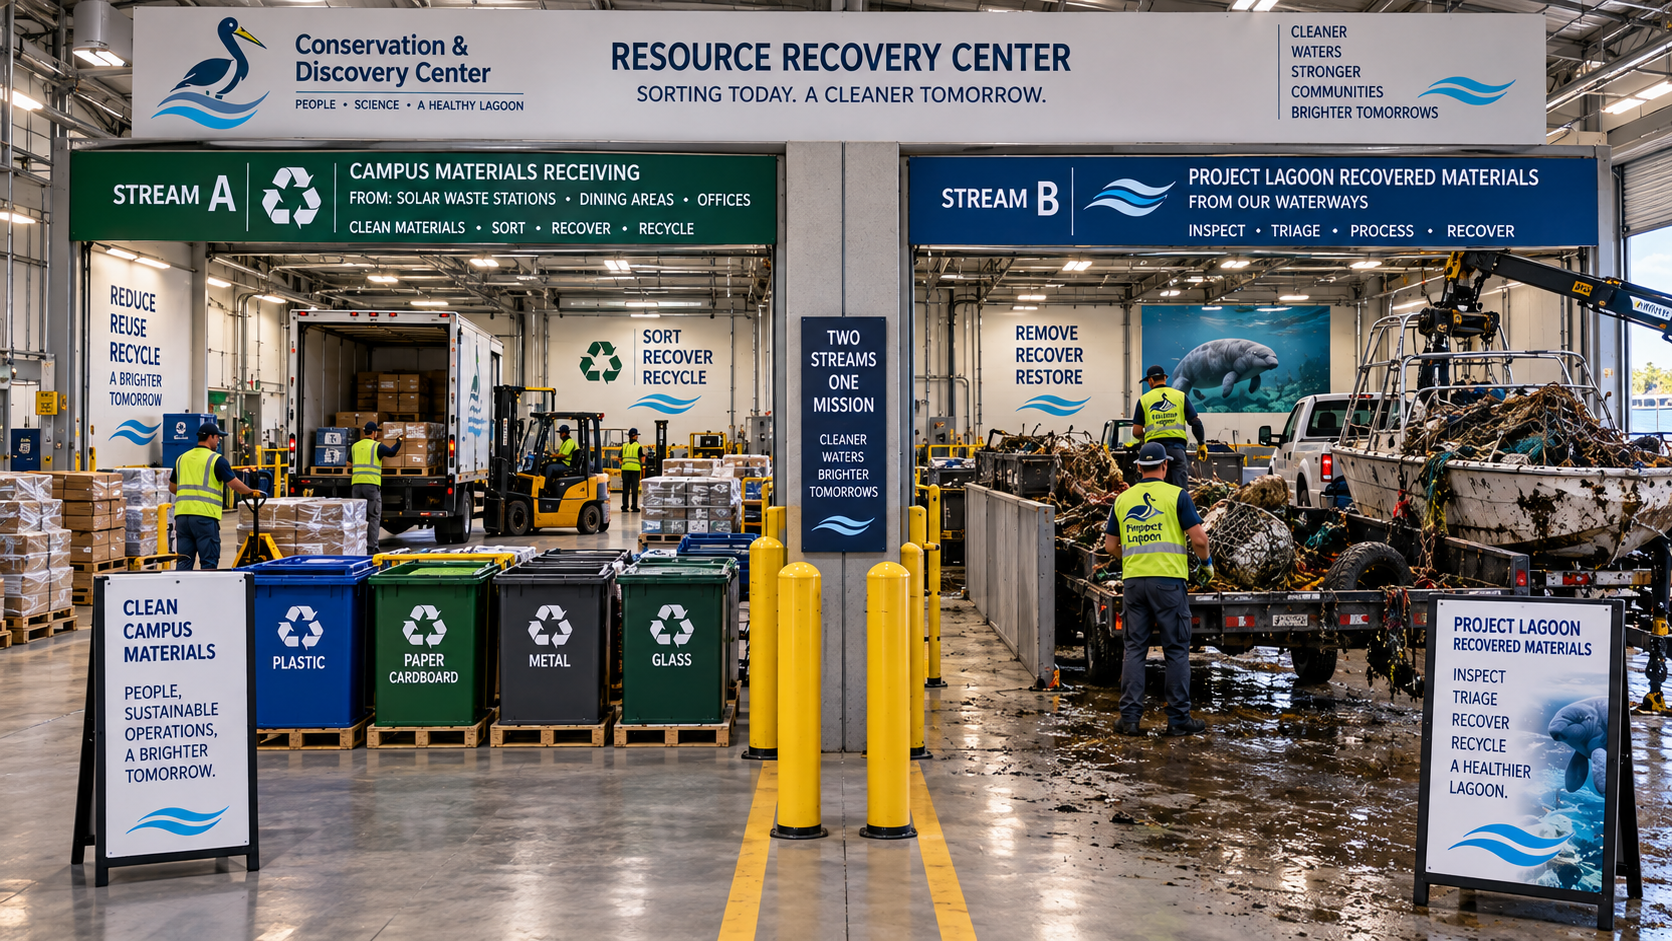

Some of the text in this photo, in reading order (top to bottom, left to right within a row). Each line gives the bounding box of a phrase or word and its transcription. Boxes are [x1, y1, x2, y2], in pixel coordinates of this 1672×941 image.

[1291, 25, 1346, 38] CLEANER
[295, 33, 468, 56] Conservation &
[1292, 46, 1341, 58] WATERS
[613, 42, 1071, 71] RESOURCE RECOVERY CENTER
[296, 61, 491, 87] Discovery Center
[1292, 66, 1360, 77] STRONGER
[638, 86, 1045, 103] SORTING TODAY. A CLEANER TOMORROW.
[1292, 86, 1383, 98] COMMUNITIES
[296, 100, 523, 110] PEOPLE SCIENCE A HEALTHY LAGOON
[1292, 106, 1438, 118] BRIGHTER TOMORROWS
[350, 163, 639, 180] CAMPUS MATERIALS RECEIVING
[1190, 168, 1538, 185] PROJECT LAGOON RECOVERED MATERIALS
[113, 175, 236, 211] STREAM A
[350, 192, 750, 206] FROM: SOLAR WASTE STATIONS DINING AREAS OFFICES
[942, 181, 1059, 215] STREAM B
[1190, 195, 1368, 209] FROM OUR WATERWAYS
[350, 221, 694, 234] CLEAN MATERIALS SORT RECOVER RECYCLE
[1190, 224, 1514, 237] INSPECT TRIAGE PROCESS RECOVER
[110, 284, 156, 313] REDUCE
[110, 313, 147, 338] REUSE
[1017, 326, 1078, 340] REMOVE
[643, 329, 682, 344] SORT
[827, 330, 860, 345] TWO
[110, 341, 161, 366] RECYCLE
[643, 349, 713, 365] RECOVER
[811, 352, 876, 366] STREAMS
[1017, 348, 1083, 362] RECOVER
[109, 371, 162, 388] A BRIGHTER
[643, 370, 707, 385] RECYCLE
[829, 375, 858, 389] ONE
[1017, 370, 1082, 384] RESTORE
[109, 391, 162, 407] TOMORROW
[814, 397, 873, 412] MISSION
[820, 434, 866, 445] CLEANER
[822, 452, 864, 462] WATERS
[819, 469, 868, 480] BRIGHTER
[810, 487, 878, 497] TOMORROWS
[124, 599, 177, 616] CLEAN
[124, 622, 192, 639] CAMPUS
[1455, 617, 1580, 636] PROJECT LAGOON
[125, 644, 215, 662] MATERIALS
[1454, 638, 1591, 656] RECOVERED MATERIALS
[273, 656, 325, 669] PLASTIC
[405, 654, 444, 666] PAPER
[530, 654, 570, 667] METAL
[652, 653, 691, 666] GLASS
[390, 671, 458, 683] CARDBOARD
[1454, 668, 1506, 683] INSPECT
[124, 684, 182, 701] PEOPLE,
[1453, 690, 1497, 706] TRIAGE
[124, 702, 219, 721] SUSTAINABLE
[1453, 713, 1509, 729] RECOVER
[124, 722, 218, 742] OPERATIONS,
[1452, 736, 1506, 752] RECYCLE
[125, 743, 208, 763] A BRIGHTER
[125, 763, 216, 784] TOMORROW.
[1451, 760, 1530, 779] A HEALTHIER
[1450, 781, 1507, 798] LAGOON.
